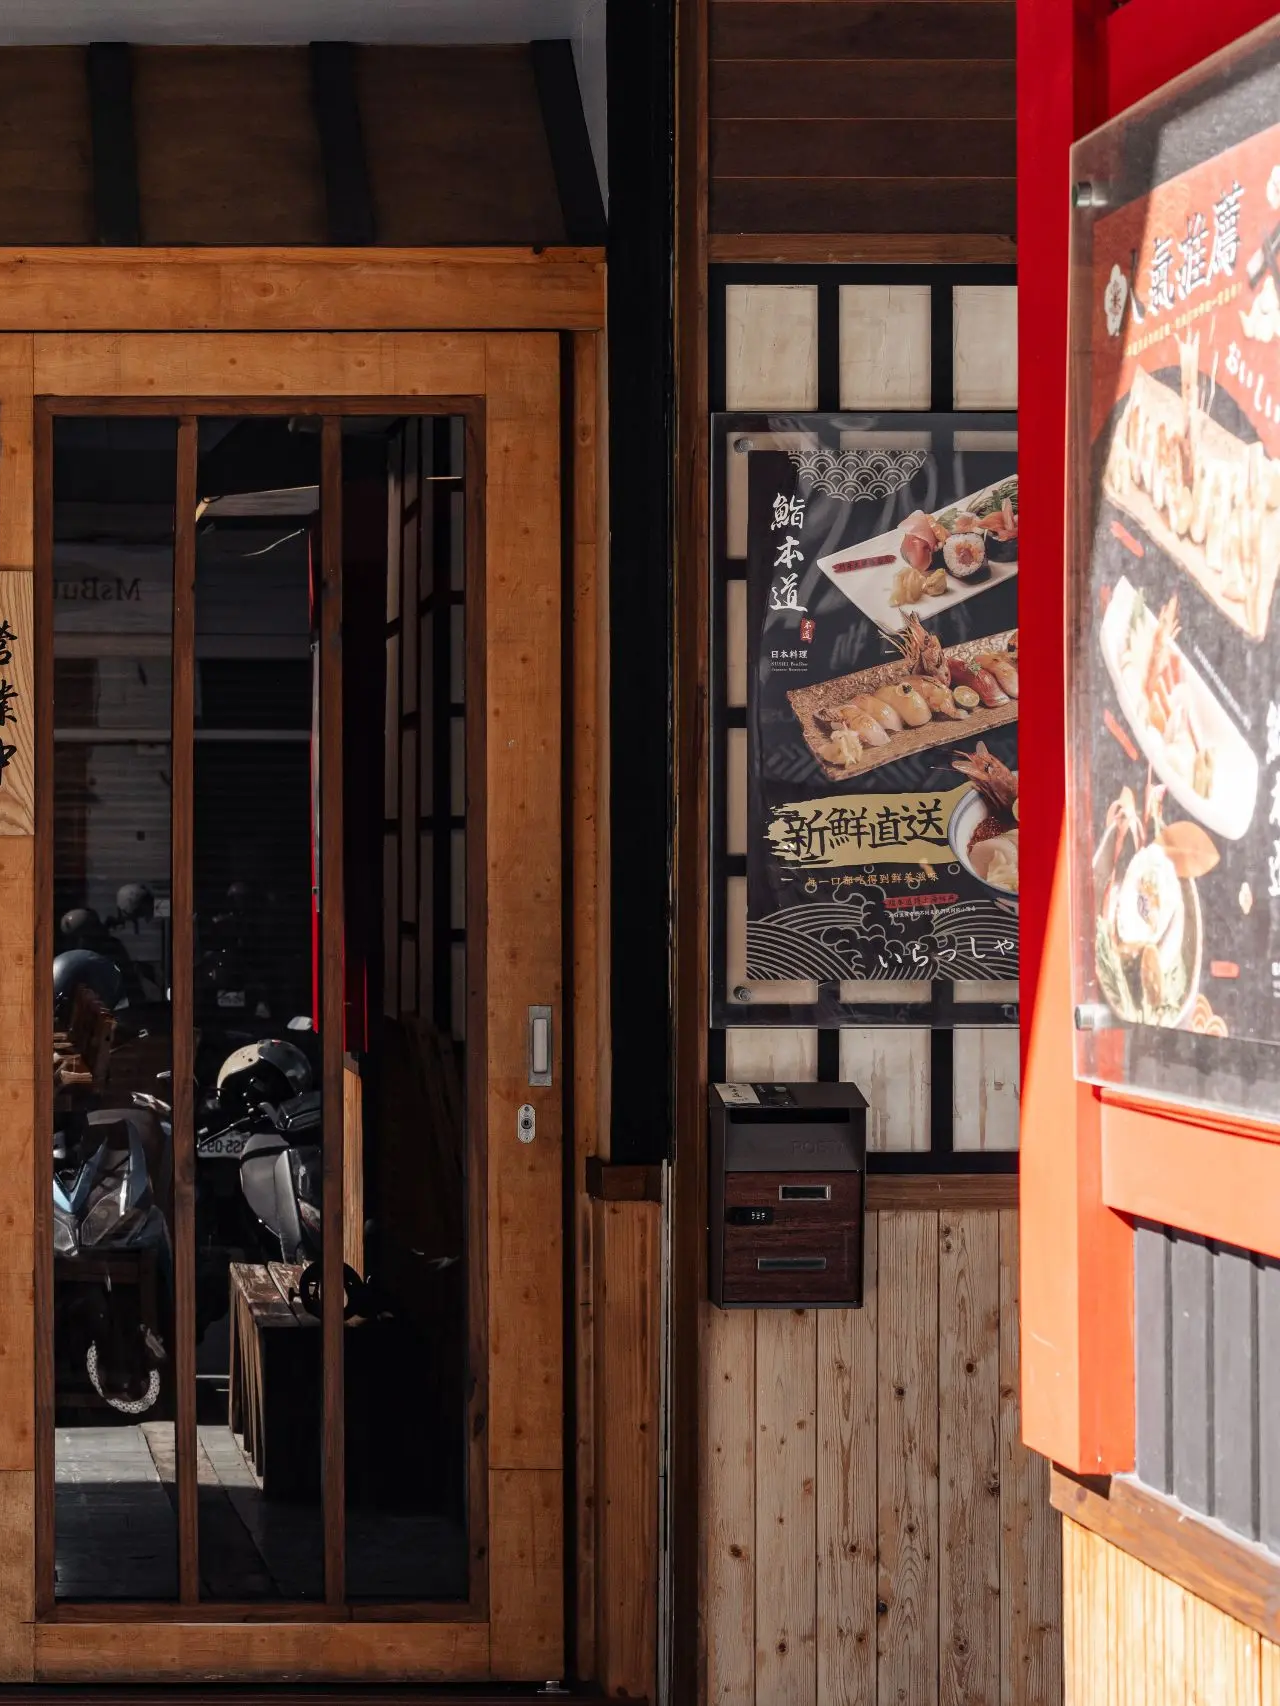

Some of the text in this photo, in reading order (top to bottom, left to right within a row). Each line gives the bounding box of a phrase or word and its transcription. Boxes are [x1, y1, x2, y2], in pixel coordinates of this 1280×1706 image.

[770, 492, 808, 613] 鮨本道
[771, 649, 808, 659] 日本料理
[784, 798, 951, 859] 新鮮直送
